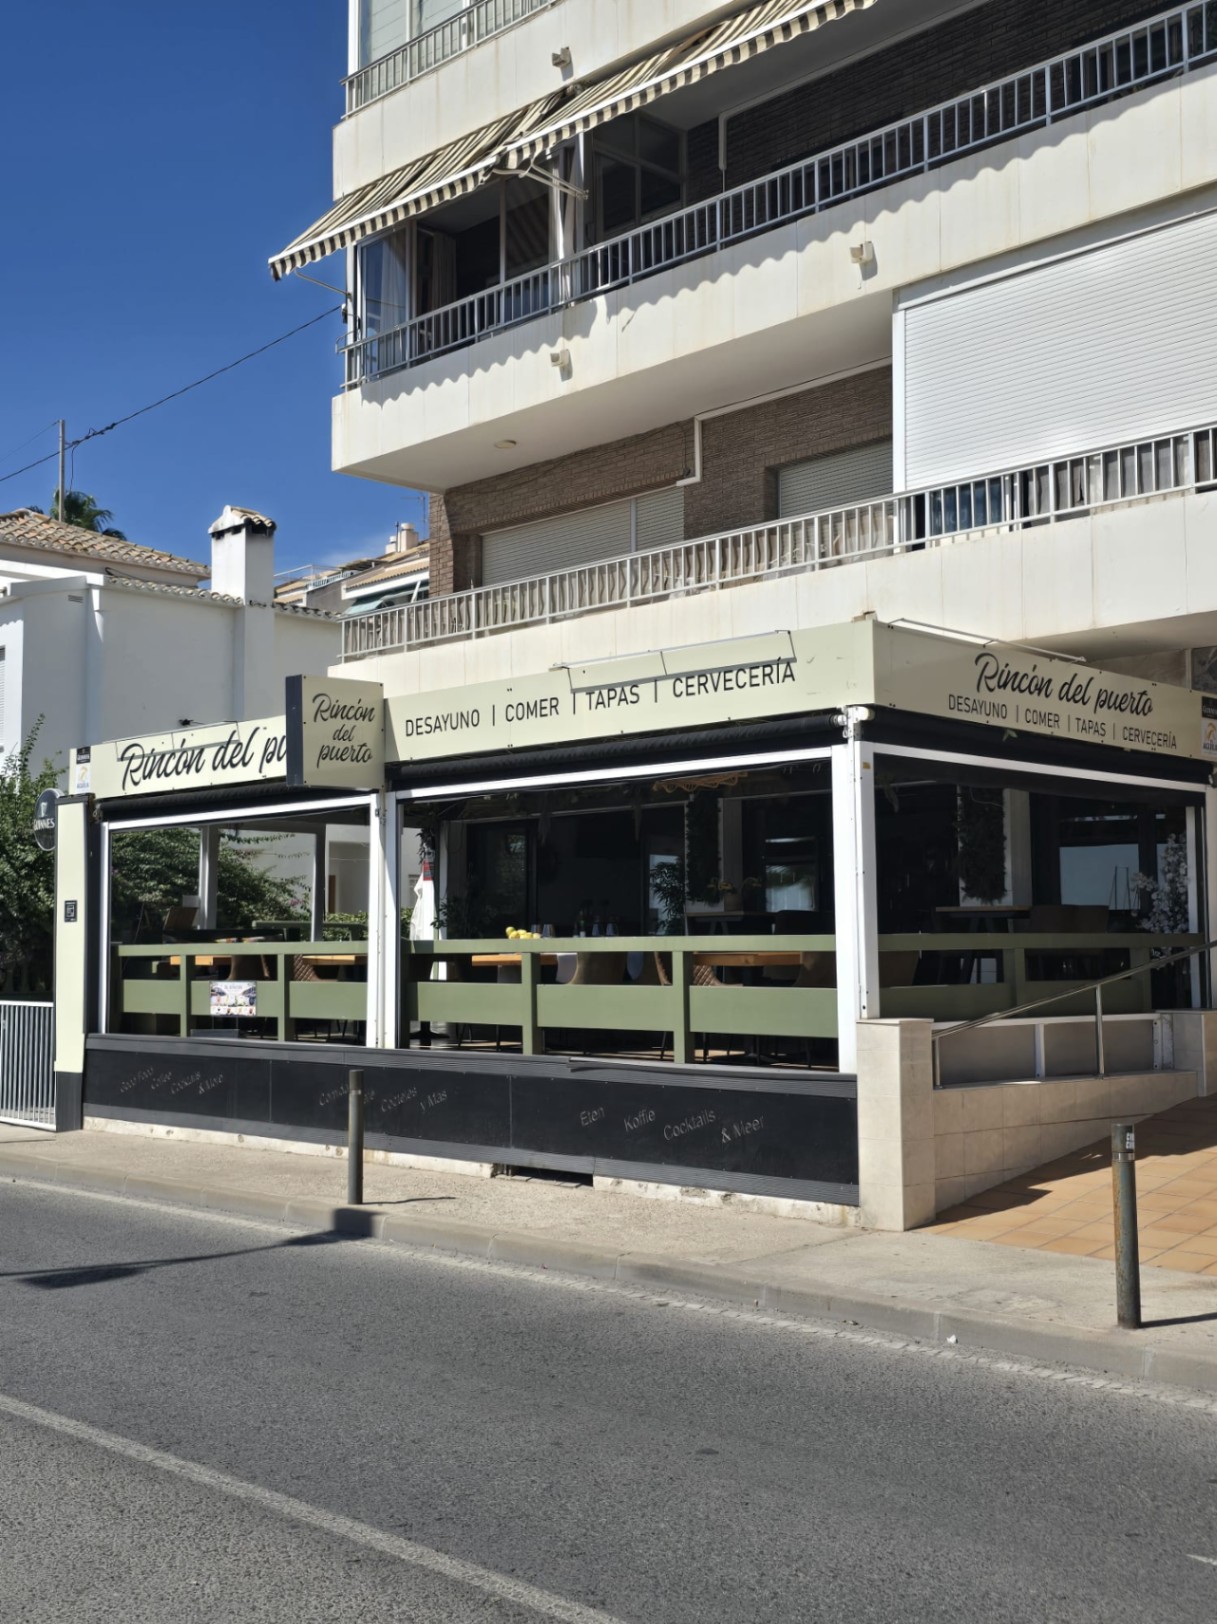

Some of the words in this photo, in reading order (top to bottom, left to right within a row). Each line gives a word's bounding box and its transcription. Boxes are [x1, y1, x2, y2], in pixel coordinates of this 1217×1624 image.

[405, 708, 480, 738] DESAYUNO
[505, 696, 560, 724] COMER
[585, 683, 641, 712] TAPAS
[672, 656, 796, 698] CERVECERÍA
[975, 652, 1052, 698] Rincón
[1058, 673, 1094, 706] del
[1094, 687, 1153, 717] puerto
[312, 692, 375, 723] Rincón
[948, 694, 1007, 719] DESAYUNO
[1024, 707, 1060, 729] COMER
[1075, 717, 1106, 737] TAPAS
[1121, 725, 1177, 749] CERVECERÍA
[333, 723, 357, 742] del
[121, 738, 205, 791] Rincón
[211, 727, 259, 771] del
[316, 742, 373, 768] puerto
[34, 817, 55, 831] GUINNES
[580, 1106, 605, 1127] Eten
[624, 1109, 656, 1132] Koffie
[663, 1109, 716, 1141] Cocktails
[732, 1115, 764, 1138] Meer
